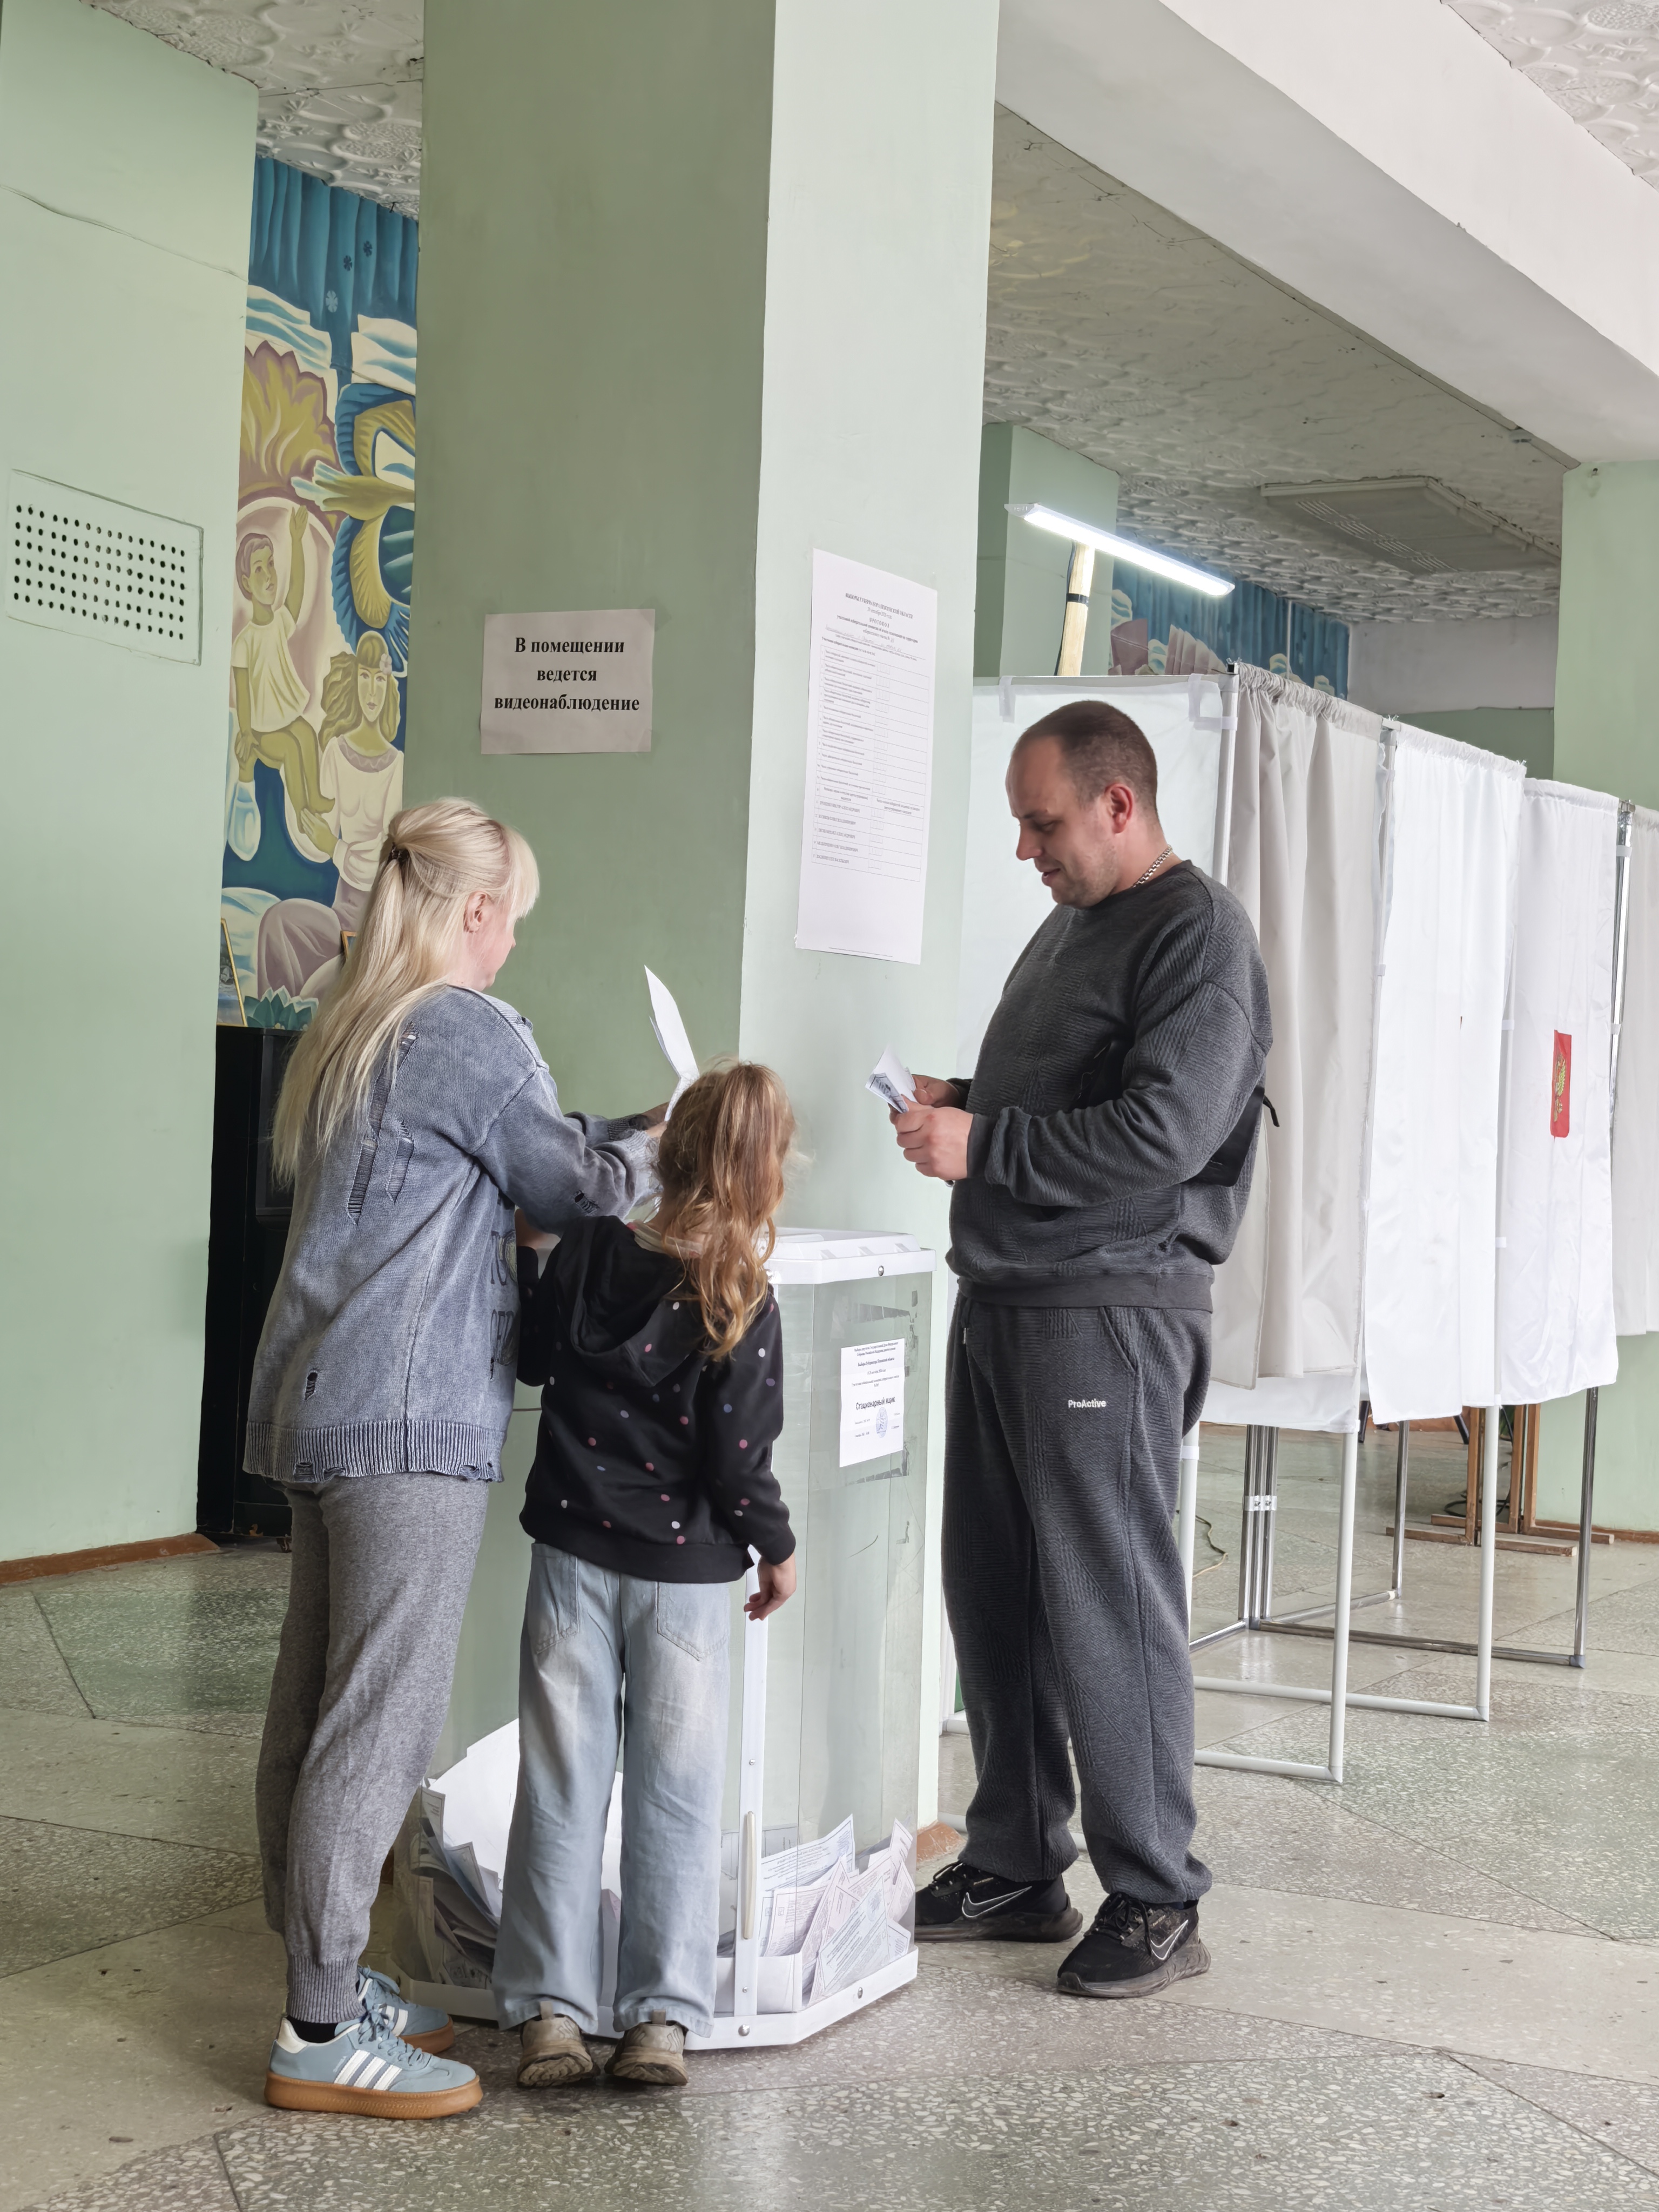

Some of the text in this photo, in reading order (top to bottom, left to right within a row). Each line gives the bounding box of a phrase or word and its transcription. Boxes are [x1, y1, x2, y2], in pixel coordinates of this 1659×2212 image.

[515, 637, 624, 655] В помещении
[537, 670, 597, 683] ведется
[494, 694, 640, 712] видеонаблюдение
[855, 1397, 885, 1411] Стационарный
[1068, 1398, 1107, 1408] ProActive
